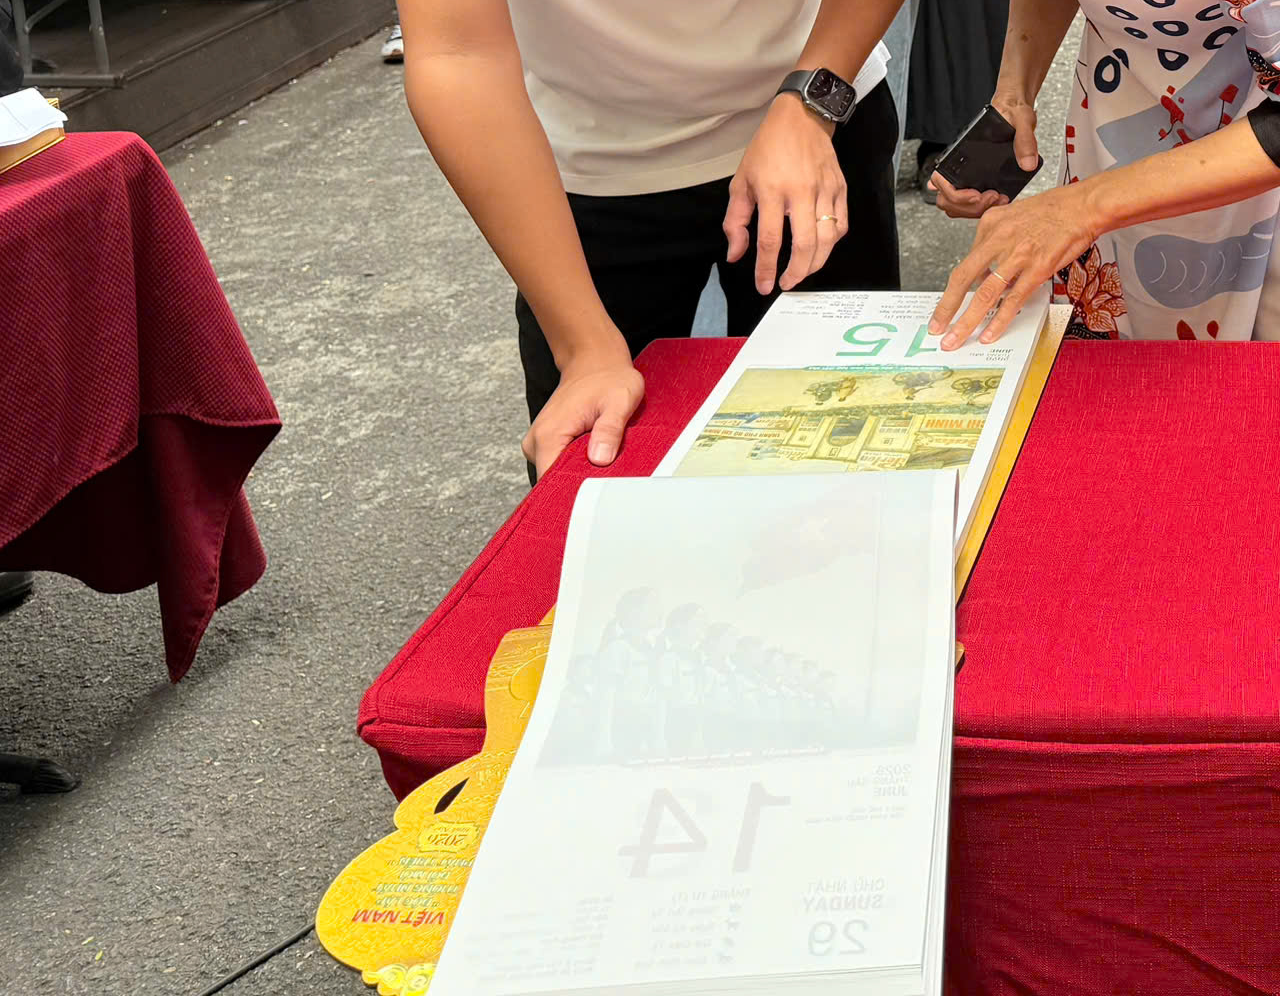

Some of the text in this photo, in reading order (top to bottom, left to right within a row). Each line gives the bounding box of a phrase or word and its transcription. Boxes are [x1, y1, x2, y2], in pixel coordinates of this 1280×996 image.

[836, 321, 938, 359] 15
[427, 833, 468, 847] 2026
[351, 908, 445, 928] VIỆT NAM
